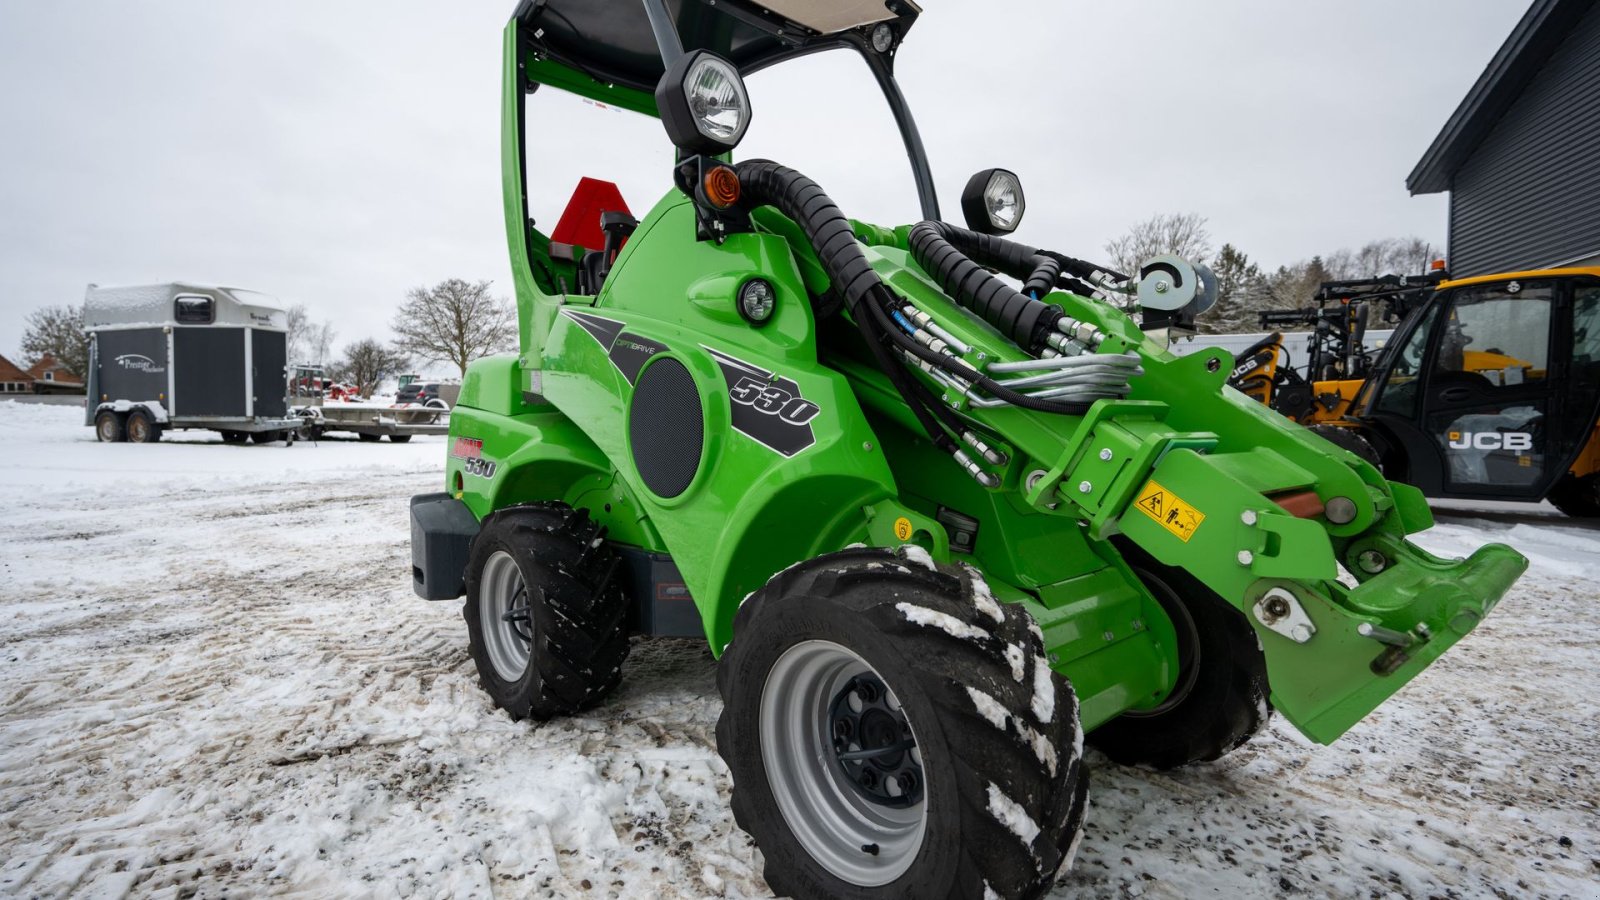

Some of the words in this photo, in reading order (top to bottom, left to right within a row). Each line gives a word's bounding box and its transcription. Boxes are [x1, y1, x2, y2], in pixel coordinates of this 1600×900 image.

[1231, 359, 1258, 379] JCB
[729, 376, 820, 426] 530
[1450, 431, 1533, 450] JCB
[464, 456, 497, 480] 530
